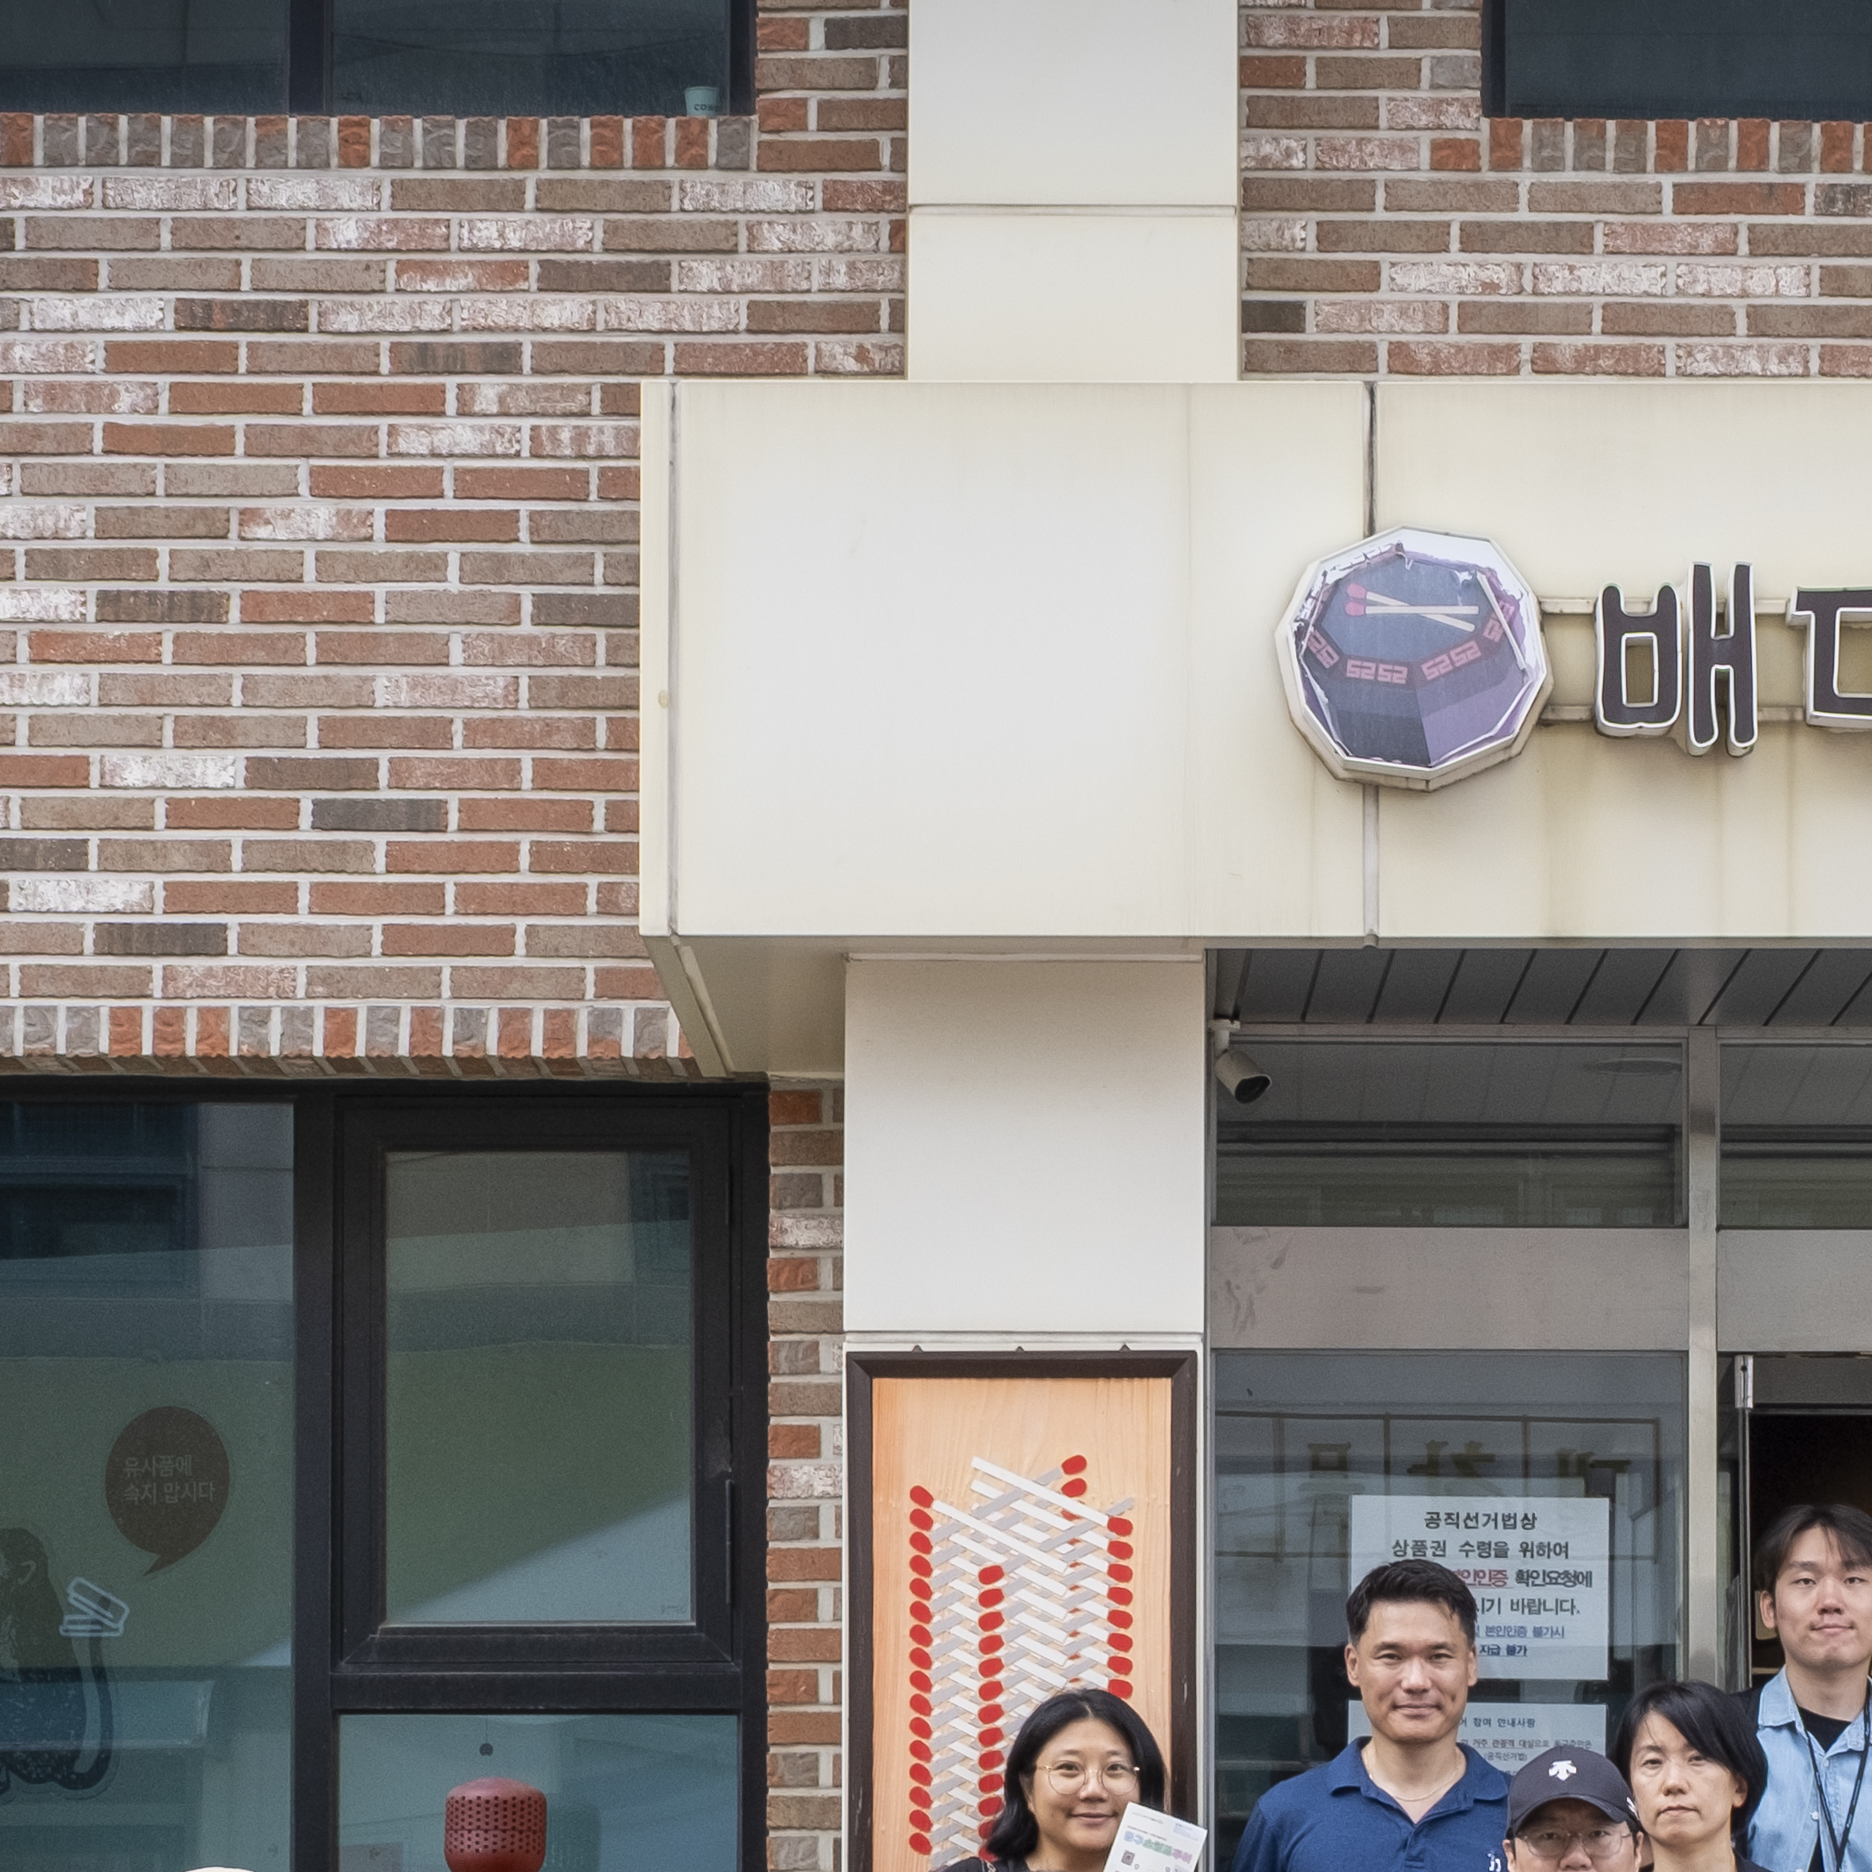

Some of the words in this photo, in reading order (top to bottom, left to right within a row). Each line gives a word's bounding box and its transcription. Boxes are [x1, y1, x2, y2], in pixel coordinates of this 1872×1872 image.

[123, 1454, 192, 1478] 유사품에
[123, 1481, 157, 1505] 속지
[163, 1480, 216, 1504] 맙시다
[1424, 1511, 1538, 1530] 공직선거법상
[1391, 1539, 1447, 1559] 상품권
[1458, 1540, 1510, 1559] 수령을
[1518, 1541, 1570, 1560] 위하여
[1455, 1569, 1509, 1588] 인인증
[1515, 1569, 1593, 1588] 확인요청에
[1510, 1598, 1581, 1615] 바랍니다.
[1485, 1626, 1527, 1638] 본인인증
[1532, 1626, 1565, 1638] 불가시
[1479, 1644, 1501, 1656] 지급
[1506, 1644, 1528, 1656] 불가
